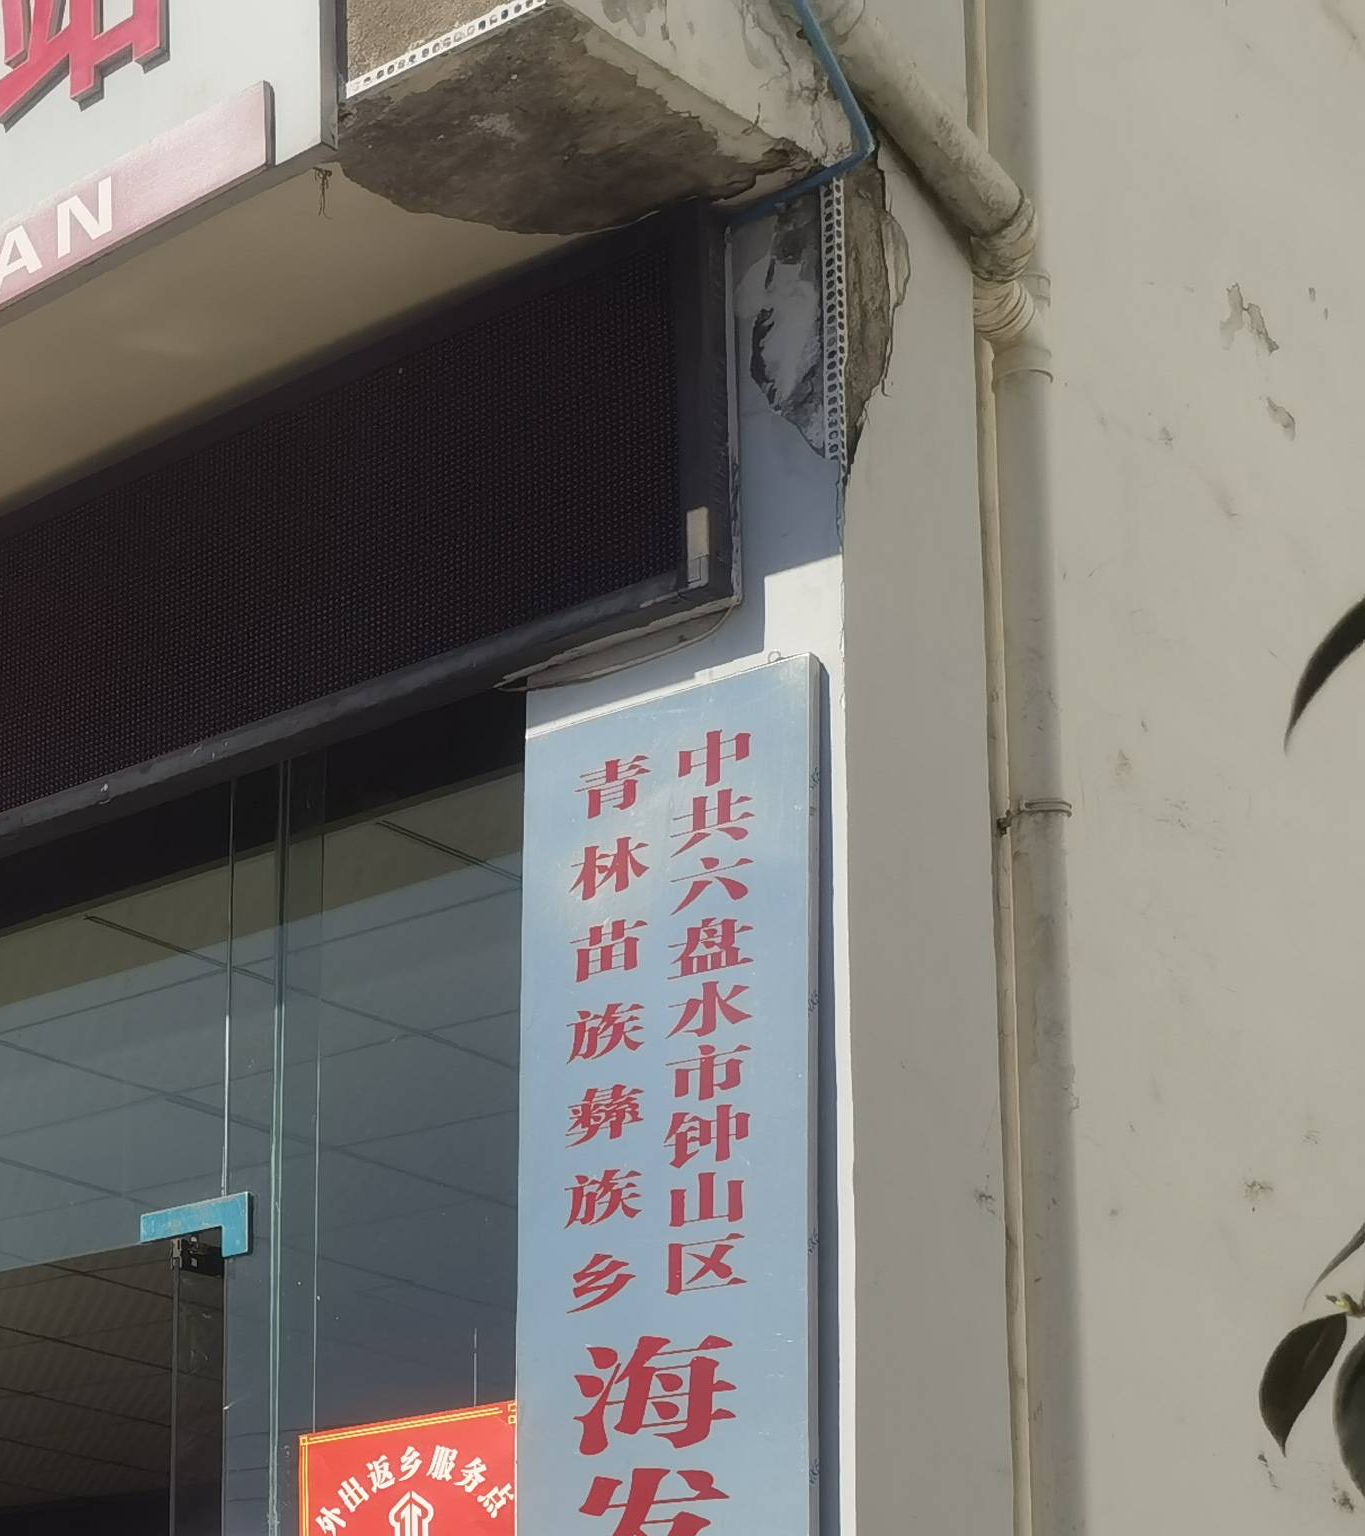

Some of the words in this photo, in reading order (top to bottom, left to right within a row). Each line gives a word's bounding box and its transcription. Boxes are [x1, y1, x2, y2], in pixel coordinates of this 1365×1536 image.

[564, 755, 651, 1315] 青林苗族彝族乡
[665, 729, 753, 1298] 中共六盘水市钟山区
